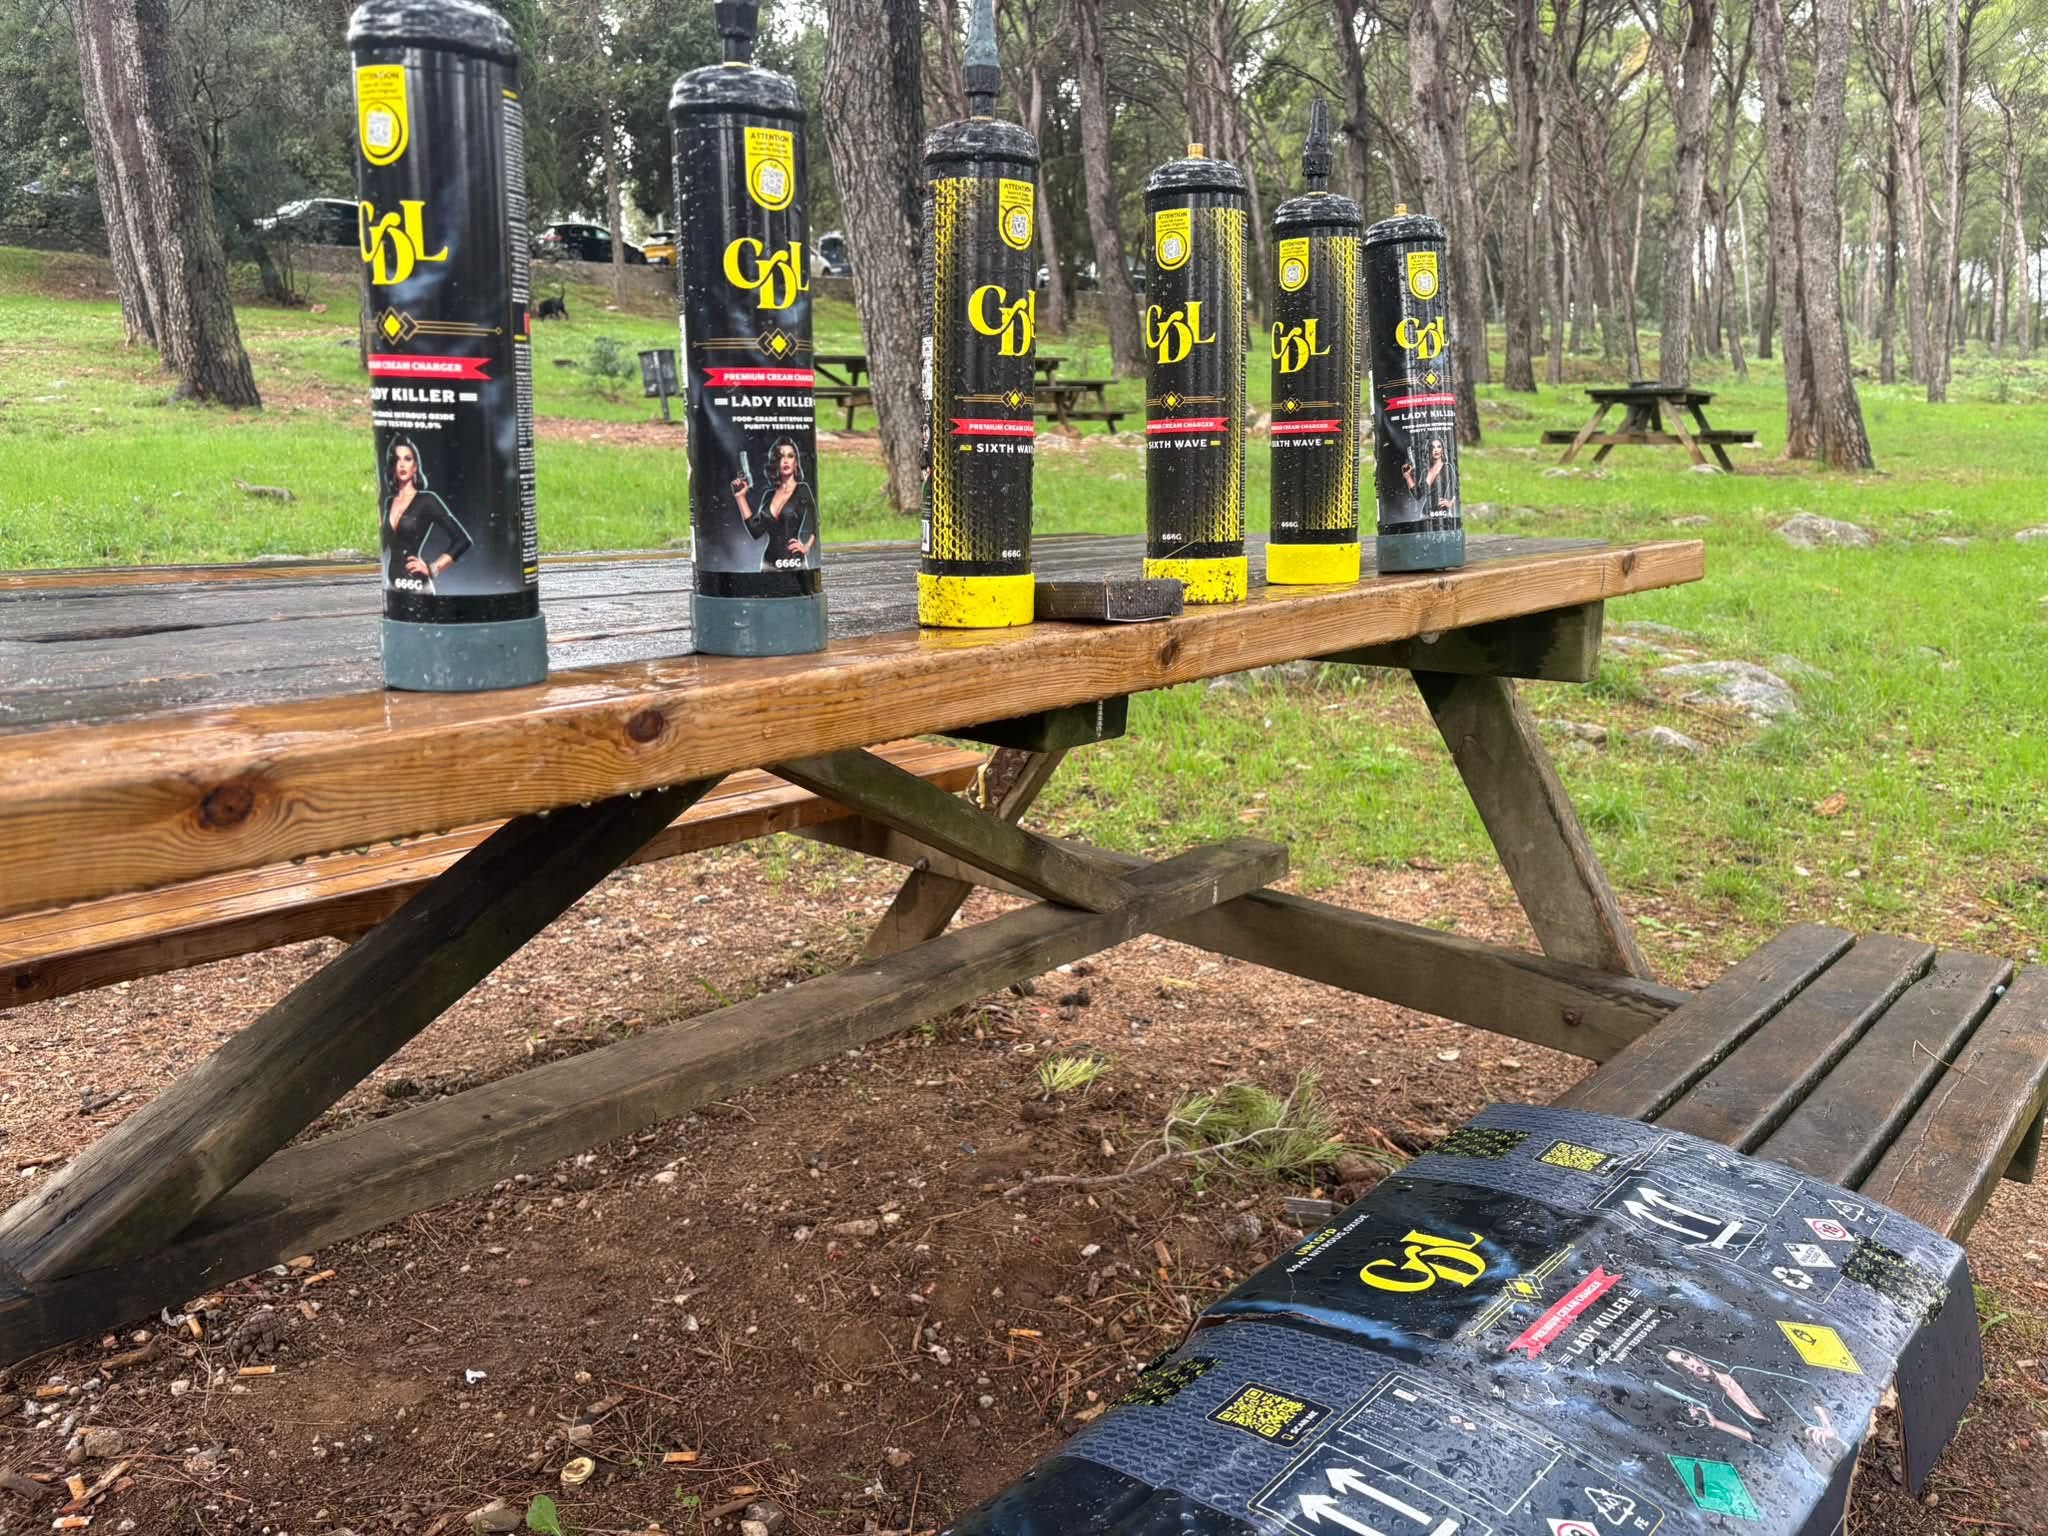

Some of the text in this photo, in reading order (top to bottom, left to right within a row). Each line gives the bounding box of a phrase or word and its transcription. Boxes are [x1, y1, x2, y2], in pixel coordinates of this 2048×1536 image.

[750, 131, 790, 142] ATTENTION
[411, 362, 463, 372] CHARGER
[723, 373, 766, 382] PREMIUM
[391, 388, 456, 403] KILLER
[731, 395, 773, 408] LADY
[428, 413, 456, 421] OXIDE
[1401, 410, 1428, 421] LADY
[414, 421, 443, 430] 99.9%
[968, 423, 1004, 431] PREMIUM
[976, 442, 1015, 454] SIXTH
[1173, 438, 1208, 449] WAVE
[1292, 438, 1322, 448] WAVE
[1162, 533, 1182, 541] 666G
[1002, 550, 1022, 559] 666G
[775, 558, 803, 572] 666G
[394, 578, 424, 591] 666G
[1308, 1231, 1347, 1258] NITROUS
[1342, 1214, 1371, 1233] OXIDE
[1294, 1228, 1338, 1256] UN1070
[1530, 1314, 1562, 1342] PREMIUM
[1574, 1280, 1603, 1303] CHARGER
[1566, 1296, 1635, 1355] LADY KILLER
[1290, 1410, 1320, 1435] SCAN ME
[1633, 1515, 1650, 1531] FE
